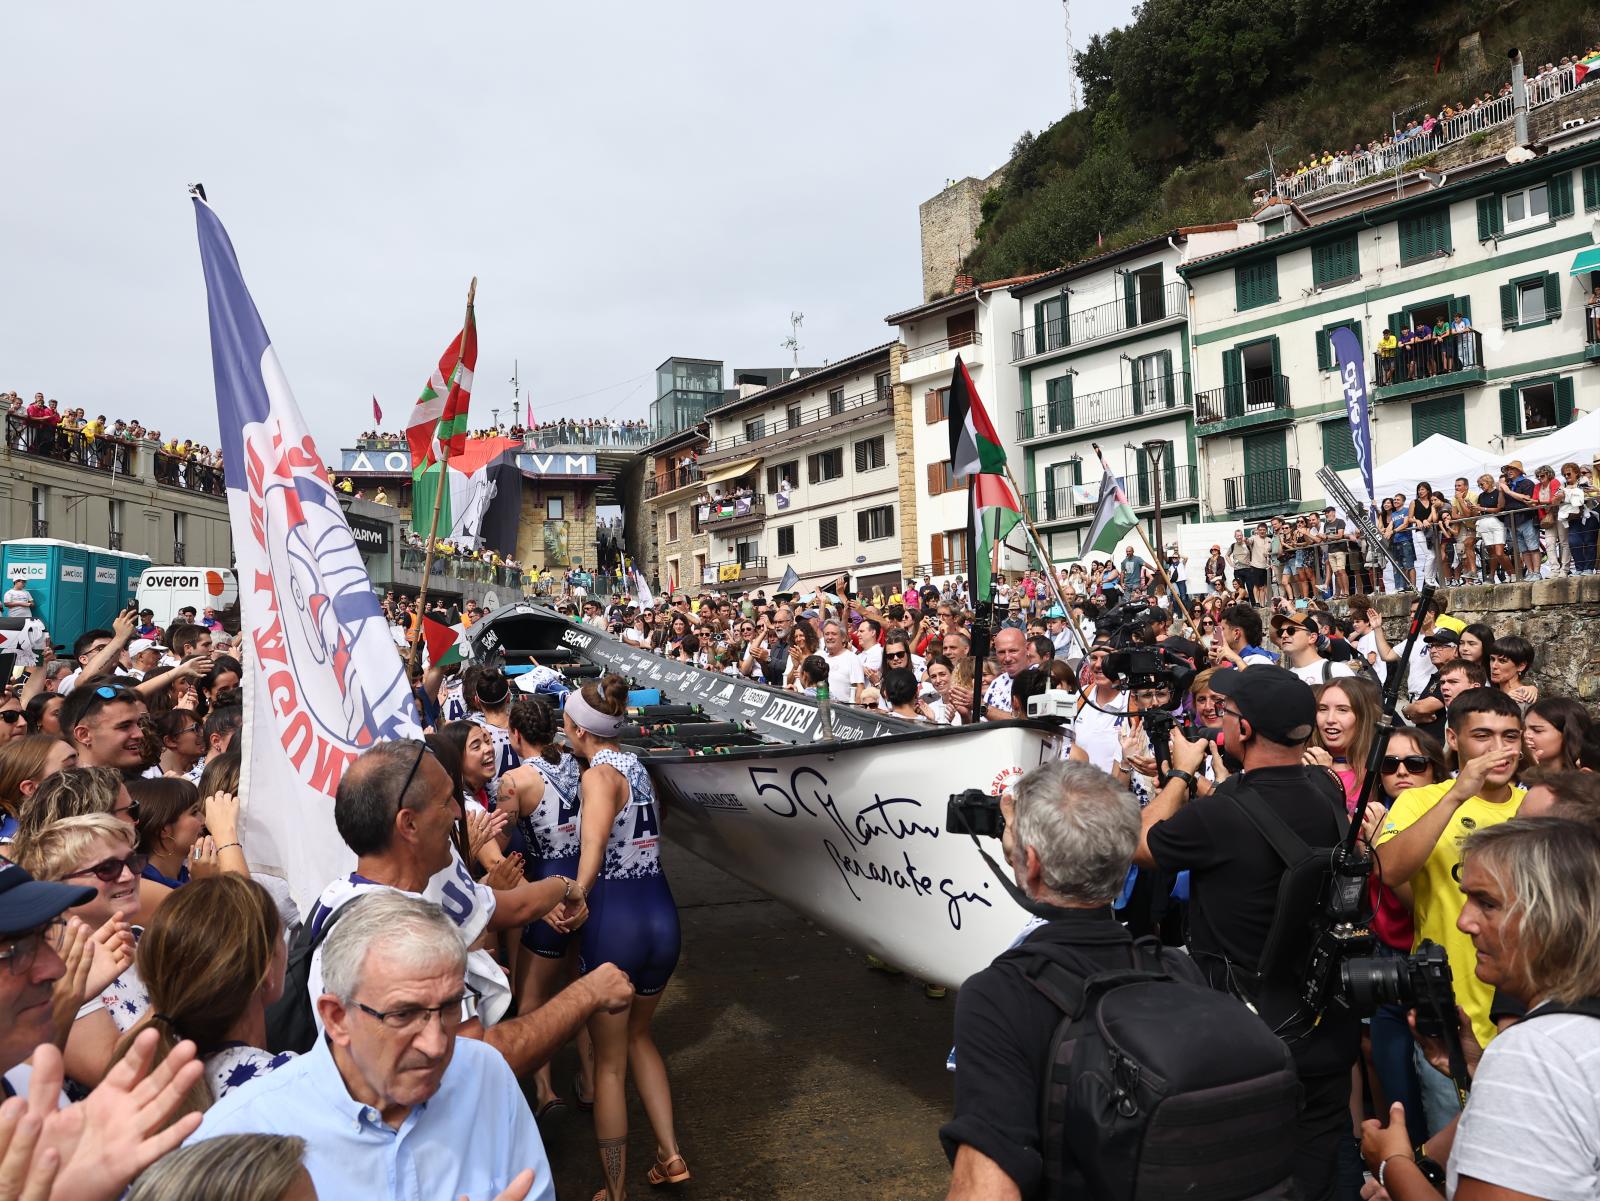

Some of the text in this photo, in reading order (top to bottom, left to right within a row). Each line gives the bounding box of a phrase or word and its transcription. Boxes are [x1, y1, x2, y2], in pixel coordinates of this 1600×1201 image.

[146, 575, 199, 588] overon
[765, 702, 815, 730] DRUCK
[832, 718, 864, 741] Lurauto
